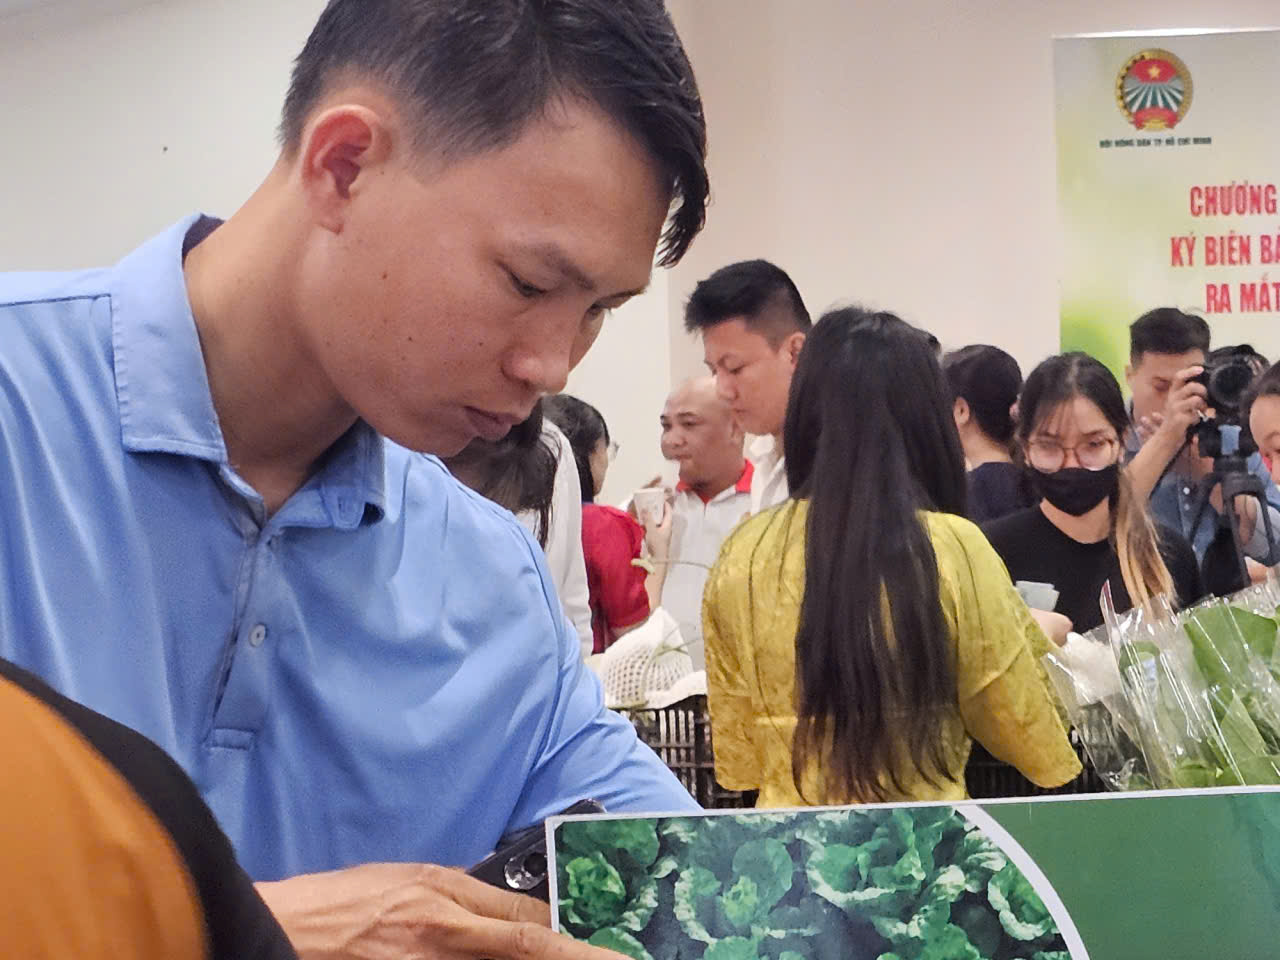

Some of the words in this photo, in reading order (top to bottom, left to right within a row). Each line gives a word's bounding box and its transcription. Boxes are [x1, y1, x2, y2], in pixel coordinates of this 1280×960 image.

[1189, 180, 1278, 217] CHƯƠNG
[1170, 231, 1197, 268] KÝ
[1206, 282, 1233, 314] RA
